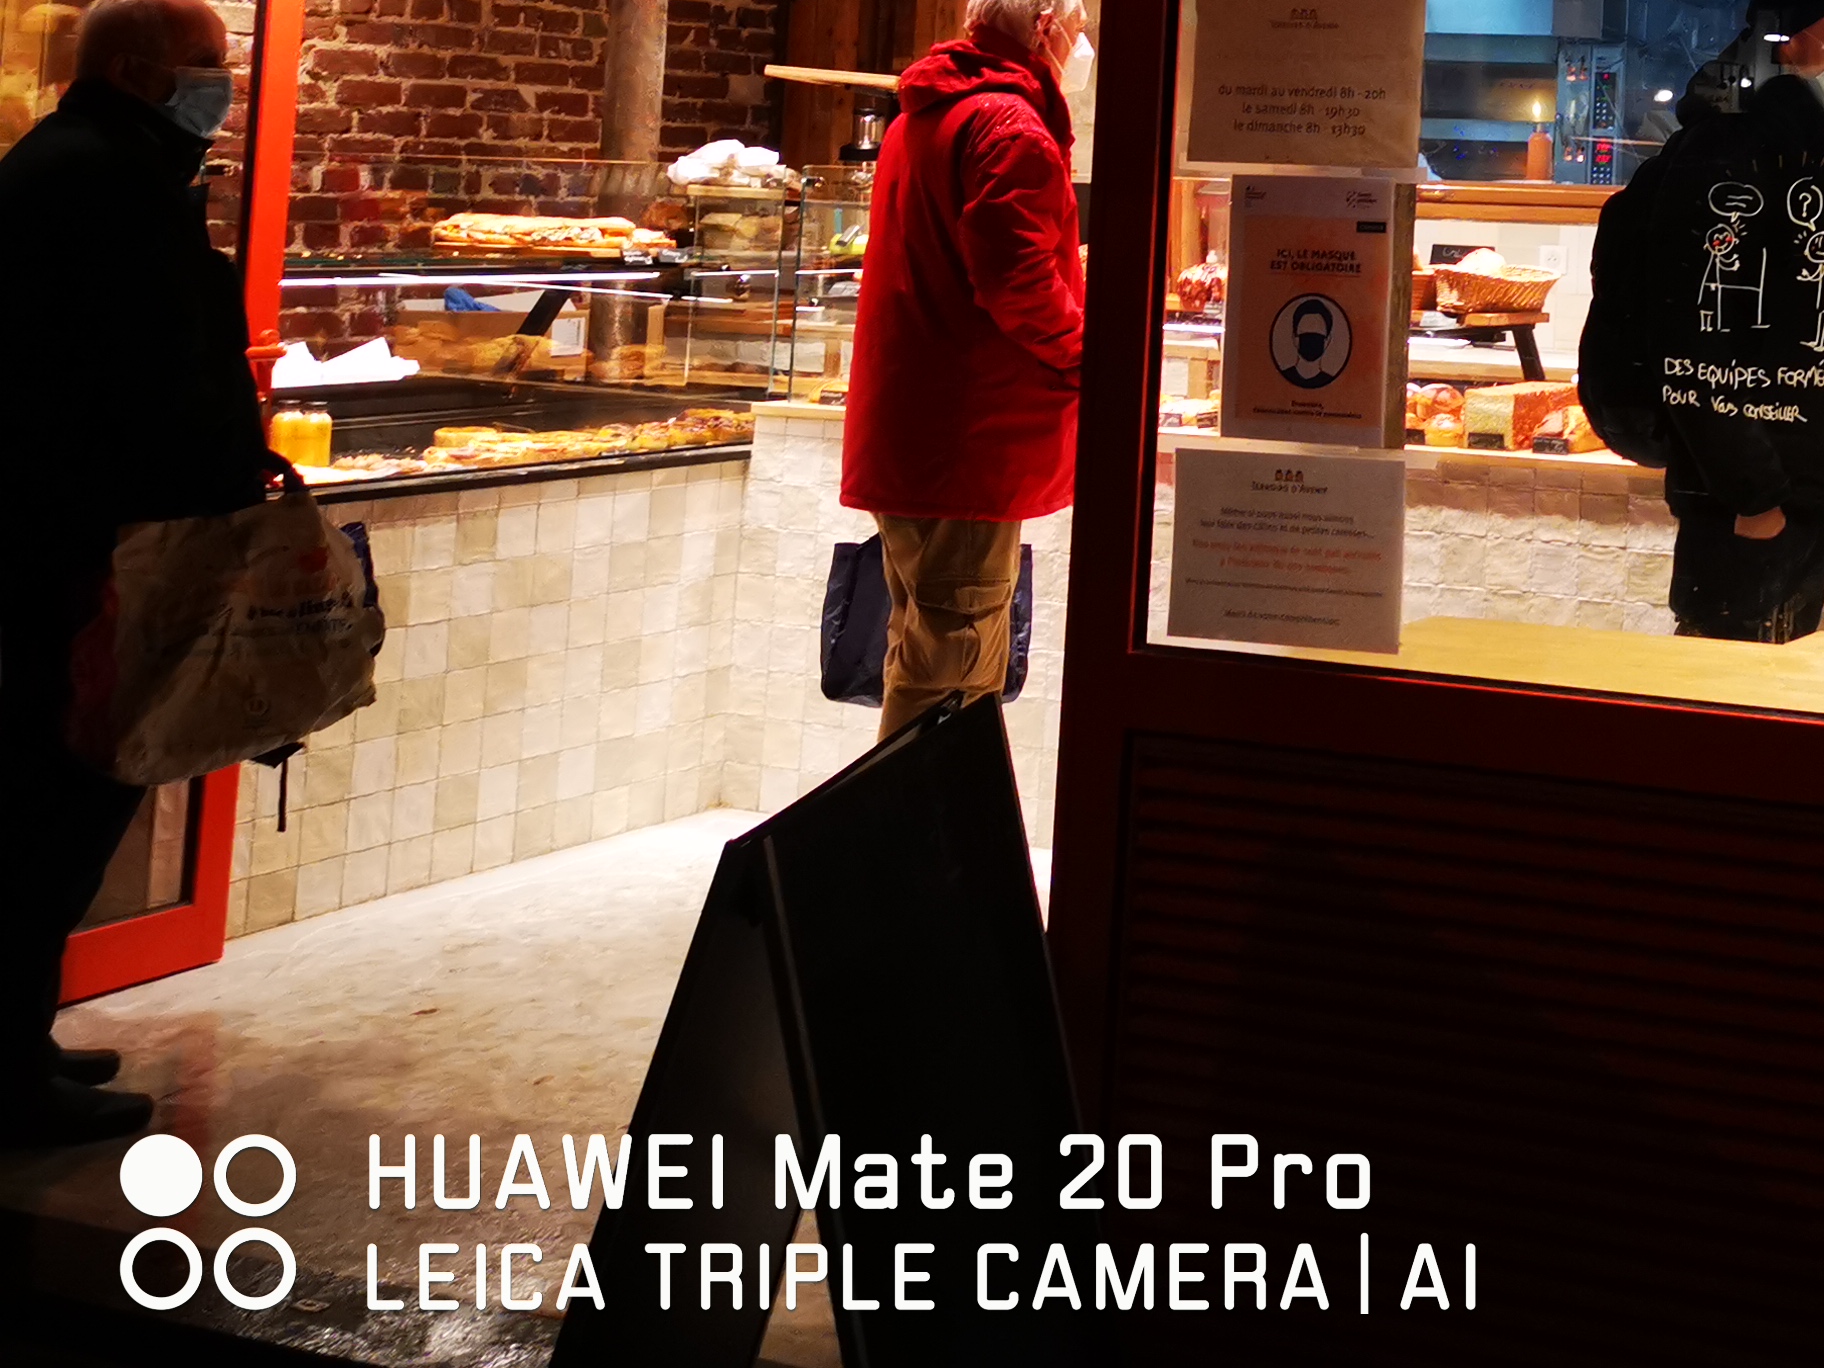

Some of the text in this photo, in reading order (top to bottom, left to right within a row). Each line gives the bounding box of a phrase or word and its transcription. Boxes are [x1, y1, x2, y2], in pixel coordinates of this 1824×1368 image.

[1218, 84, 1232, 96] du
[1236, 84, 1267, 97] mardi
[1270, 87, 1286, 97] au
[1288, 84, 1337, 99] vendredi
[1339, 85, 1355, 99] 8h
[1364, 87, 1386, 100] 20h
[1242, 102, 1253, 115] le
[1255, 103, 1297, 116] samedi
[1234, 118, 1245, 132] le
[1246, 119, 1303, 133] dimanche
[1305, 122, 1320, 134] 8h
[1277, 248, 1357, 262] ICI, LE MASQUE
[1270, 260, 1362, 274] EST OBLIGATOIRE
[1664, 357, 1694, 376] DES
[1697, 359, 1771, 390] EQUIPES
[1662, 384, 1700, 408] POUR
